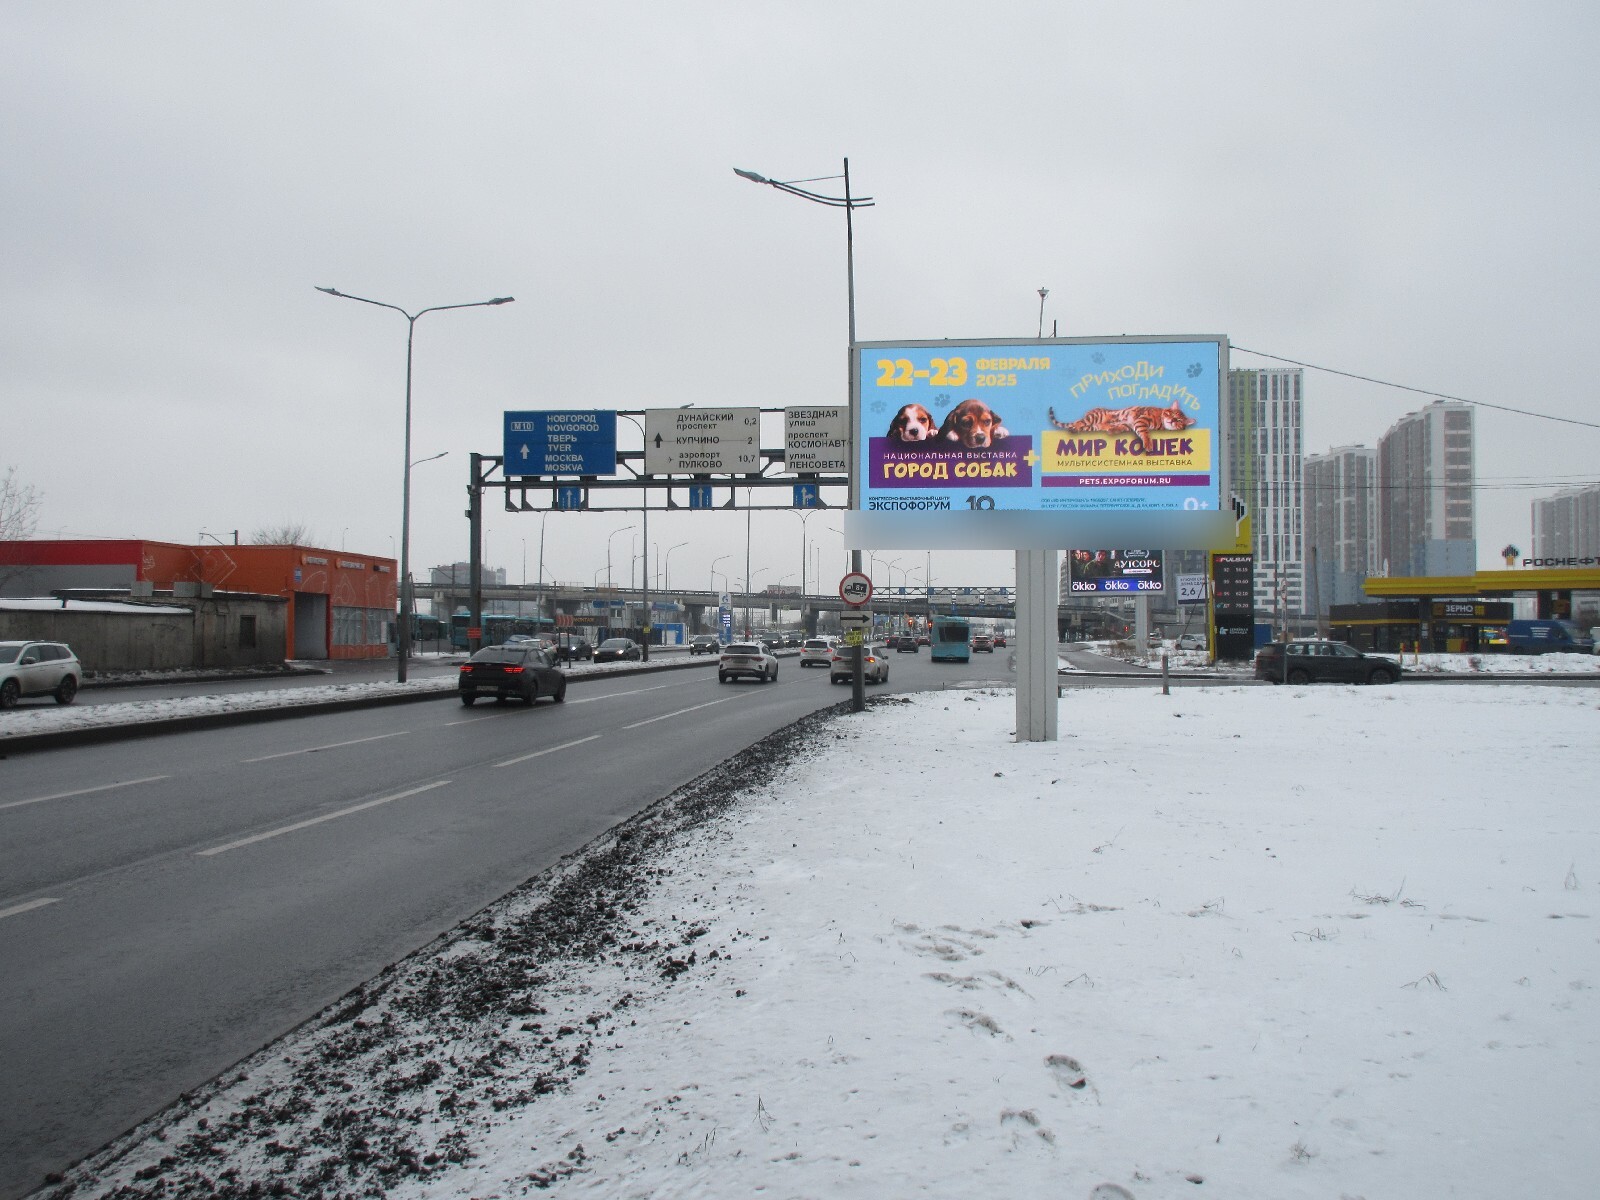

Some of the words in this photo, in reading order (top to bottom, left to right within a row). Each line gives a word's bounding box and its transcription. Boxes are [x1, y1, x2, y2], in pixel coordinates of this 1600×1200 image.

[876, 357, 968, 387] 22-23
[976, 357, 1051, 371] ФЕВРАЛЯ
[976, 374, 1017, 387] 2025
[1070, 361, 1165, 398] ПРИХОДИ
[1108, 383, 1201, 411] ПОГЛАДИТЬ
[546, 414, 597, 423] НОВГОРОД
[788, 410, 838, 419] ЗВЕЗДНАЯ
[676, 413, 734, 422] ДУНАЙСКИЙ
[744, 417, 757, 427] 0,2
[789, 420, 816, 428] улица
[546, 424, 600, 432] NOVGOROD
[676, 423, 717, 431] проспект
[547, 434, 578, 442] ТВЕРЬ
[676, 436, 720, 444] КУПЧИНО
[747, 437, 753, 445] 2
[788, 432, 829, 440] проспект
[547, 444, 572, 452] TVER
[788, 439, 850, 448] КОСМОНАВТ
[1056, 438, 1107, 456] МИР
[1115, 437, 1194, 456] КОШЕК
[545, 454, 584, 462] МОСКВА
[679, 452, 721, 460] аэропорт
[738, 455, 756, 463] 10,7
[883, 451, 963, 461] НАЦИОНАЛЬНАЯ
[966, 450, 1018, 459] ВЫСТАВКА
[678, 460, 723, 468] ПУЛКОВО
[789, 461, 846, 469] ЛЕНСОВЕТА
[1057, 459, 1144, 467] МУЛЬТИСИСТЕМНАЯ
[1146, 458, 1193, 466] ВЫСТАВКА
[883, 462, 948, 480] ГОРОД
[954, 461, 1018, 478] СОБАК
[1079, 477, 1171, 485] PETS.EXPOFORUM.RU
[868, 501, 951, 511] ЭКСПОФОРУМ
[1445, 605, 1474, 613] ЗЕРНО
